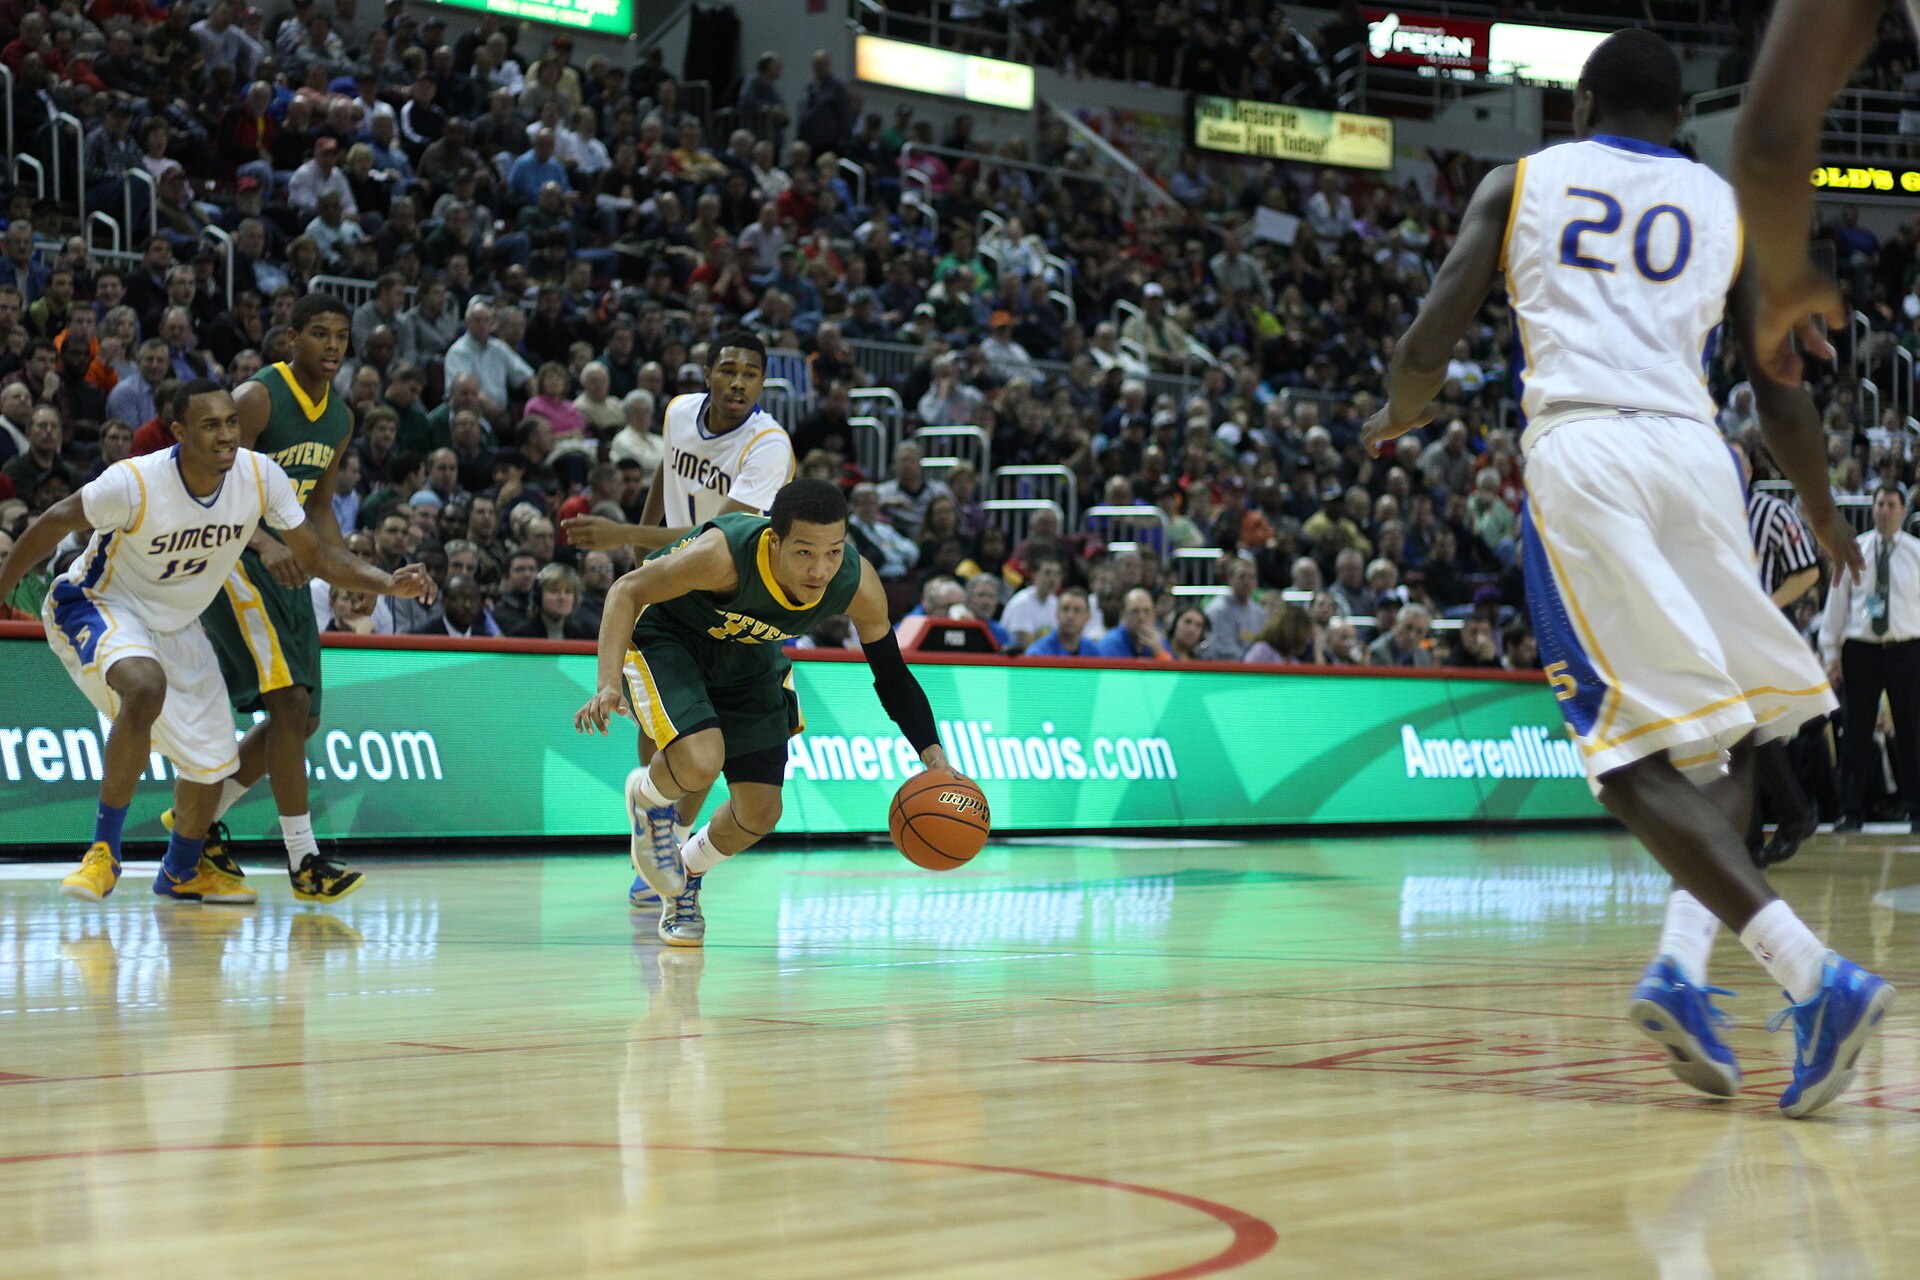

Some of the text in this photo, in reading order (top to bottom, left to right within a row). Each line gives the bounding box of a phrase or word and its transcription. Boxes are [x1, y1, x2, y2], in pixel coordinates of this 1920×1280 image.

[1393, 31, 1472, 58] PEKIN
[1558, 184, 1693, 284] 20
[672, 447, 731, 496] IMEON
[784, 720, 1178, 781] AmereIllinois.com
